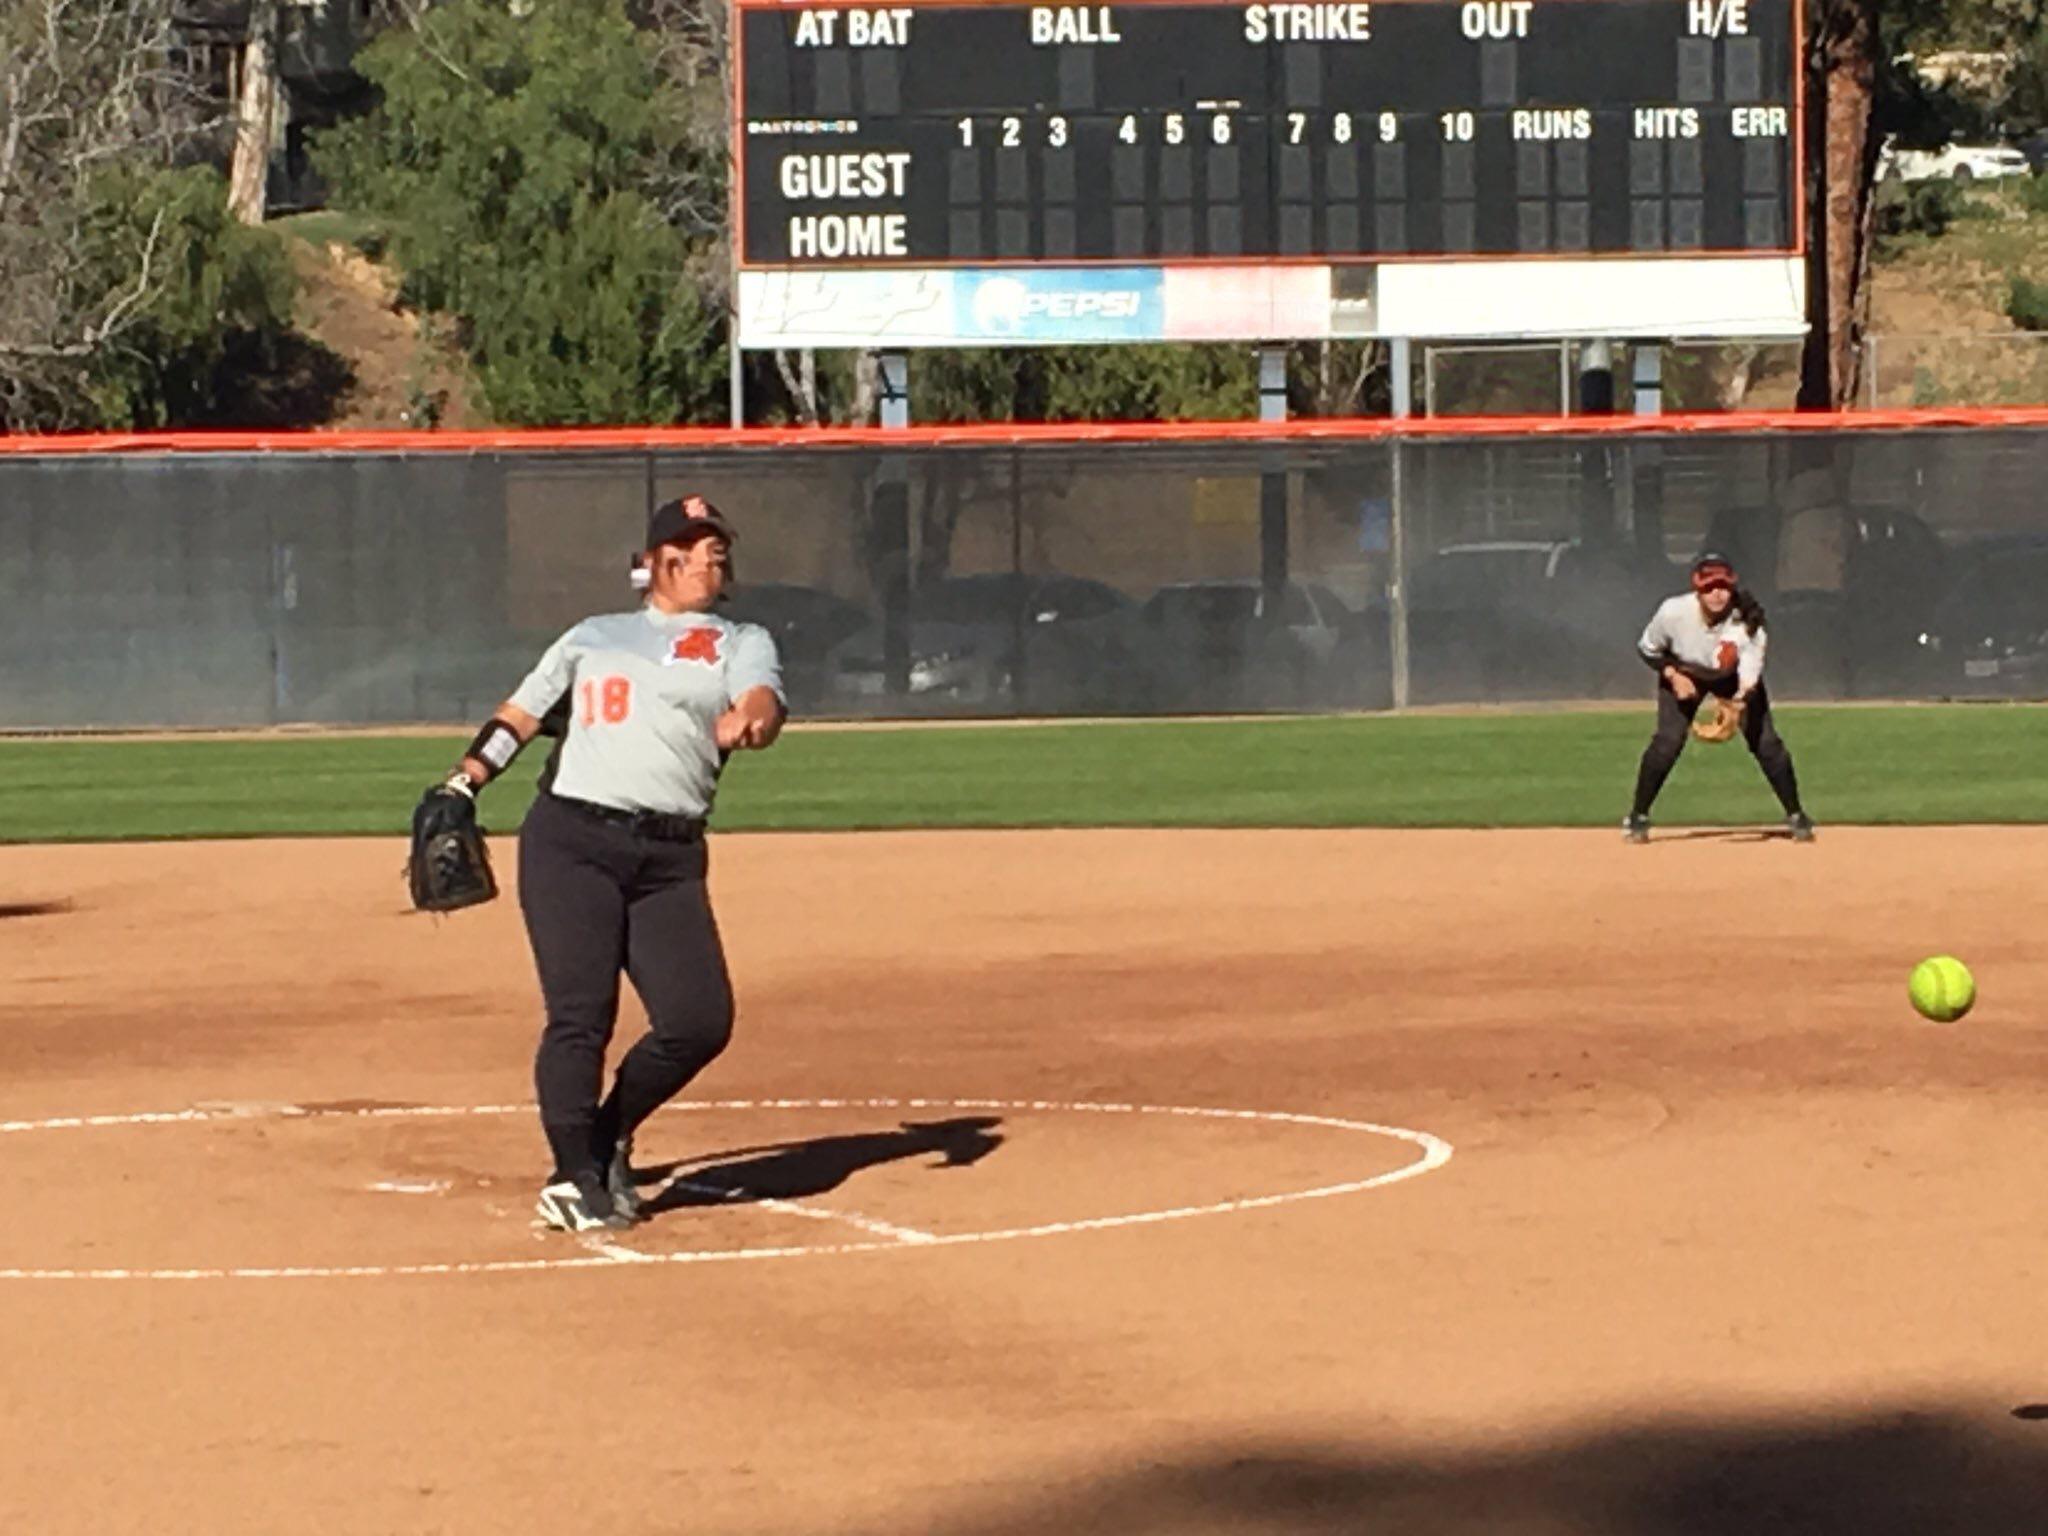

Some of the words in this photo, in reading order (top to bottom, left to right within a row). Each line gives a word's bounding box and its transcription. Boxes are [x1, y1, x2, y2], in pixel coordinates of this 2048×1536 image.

[795, 9, 838, 46] AT
[848, 9, 913, 46] BAT
[1031, 6, 1121, 43] BALL
[1245, 3, 1371, 42] STRIKE
[1461, 1, 1534, 39] OUT
[1689, 0, 1748, 37] H/E
[958, 117, 973, 147] 1
[1002, 117, 1021, 147] 2
[1048, 116, 1067, 147] 3
[1119, 115, 1137, 144] 4
[1166, 114, 1184, 144] 5
[1212, 114, 1231, 144] 6
[1287, 113, 1305, 143] 7
[1334, 112, 1352, 143] 8
[1379, 112, 1397, 142] 9
[1441, 111, 1474, 142] 10
[1512, 108, 1592, 140] RUNS
[1634, 107, 1699, 138] HITS
[1731, 106, 1788, 137] ERR
[781, 153, 911, 199] GUEST
[789, 214, 908, 258] HOME
[1019, 290, 1141, 318] PEPSI
[579, 675, 631, 728] 18
